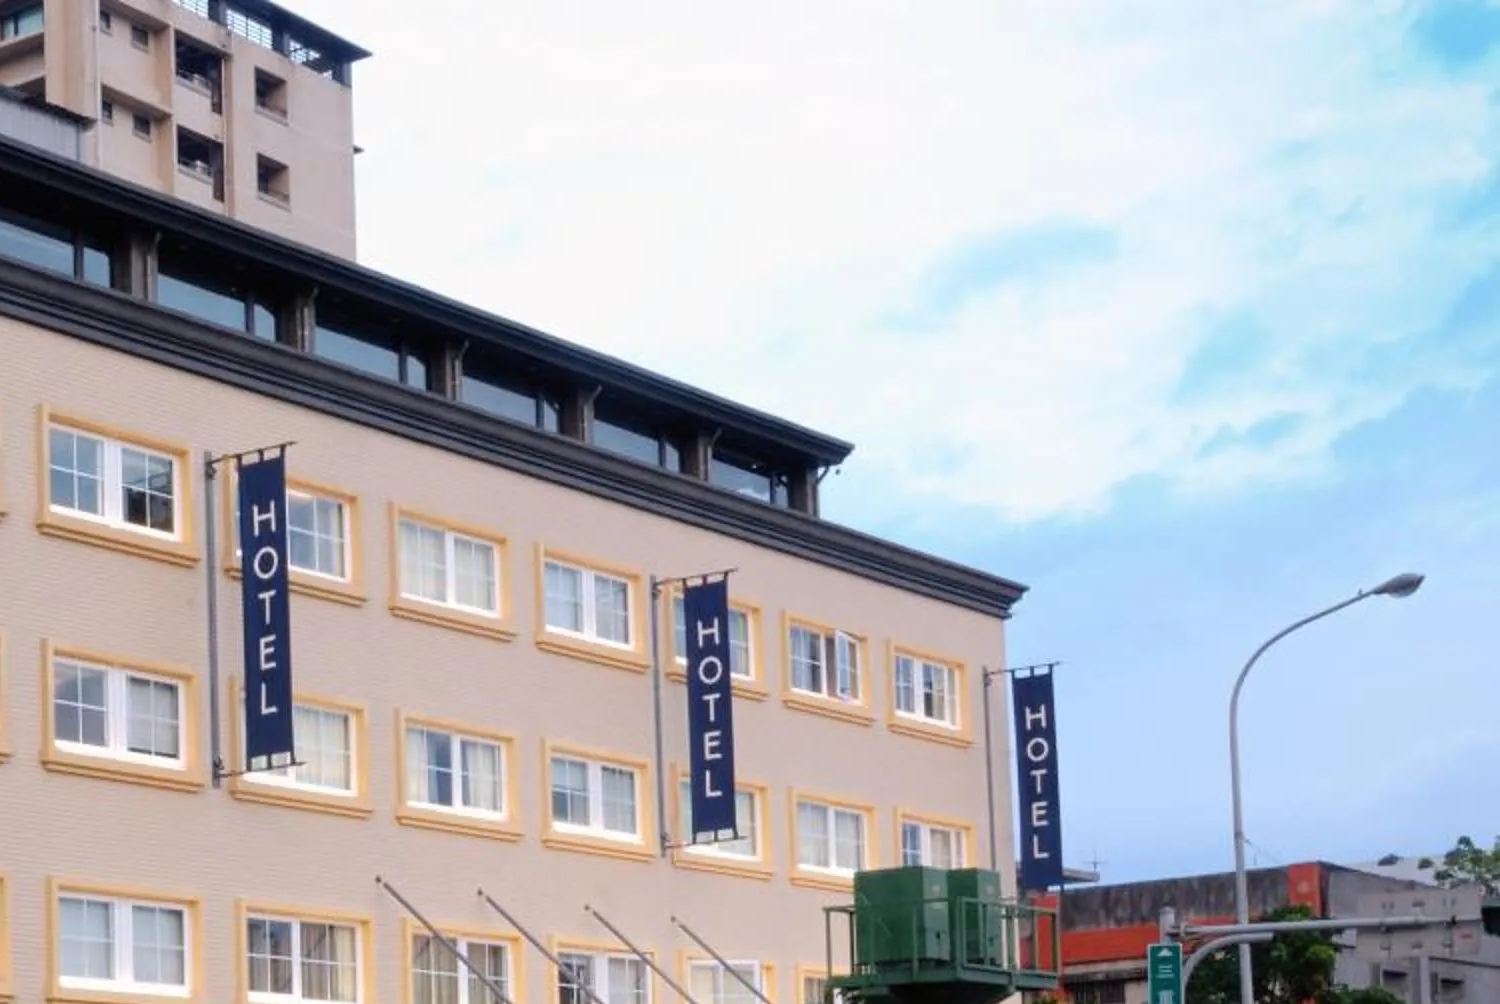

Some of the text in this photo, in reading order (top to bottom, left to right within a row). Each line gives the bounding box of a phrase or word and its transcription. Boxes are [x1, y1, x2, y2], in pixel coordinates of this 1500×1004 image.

[252, 500, 279, 715] HOTEL
[697, 617, 723, 798] HOTEL
[1025, 704, 1050, 860] HOTEL
